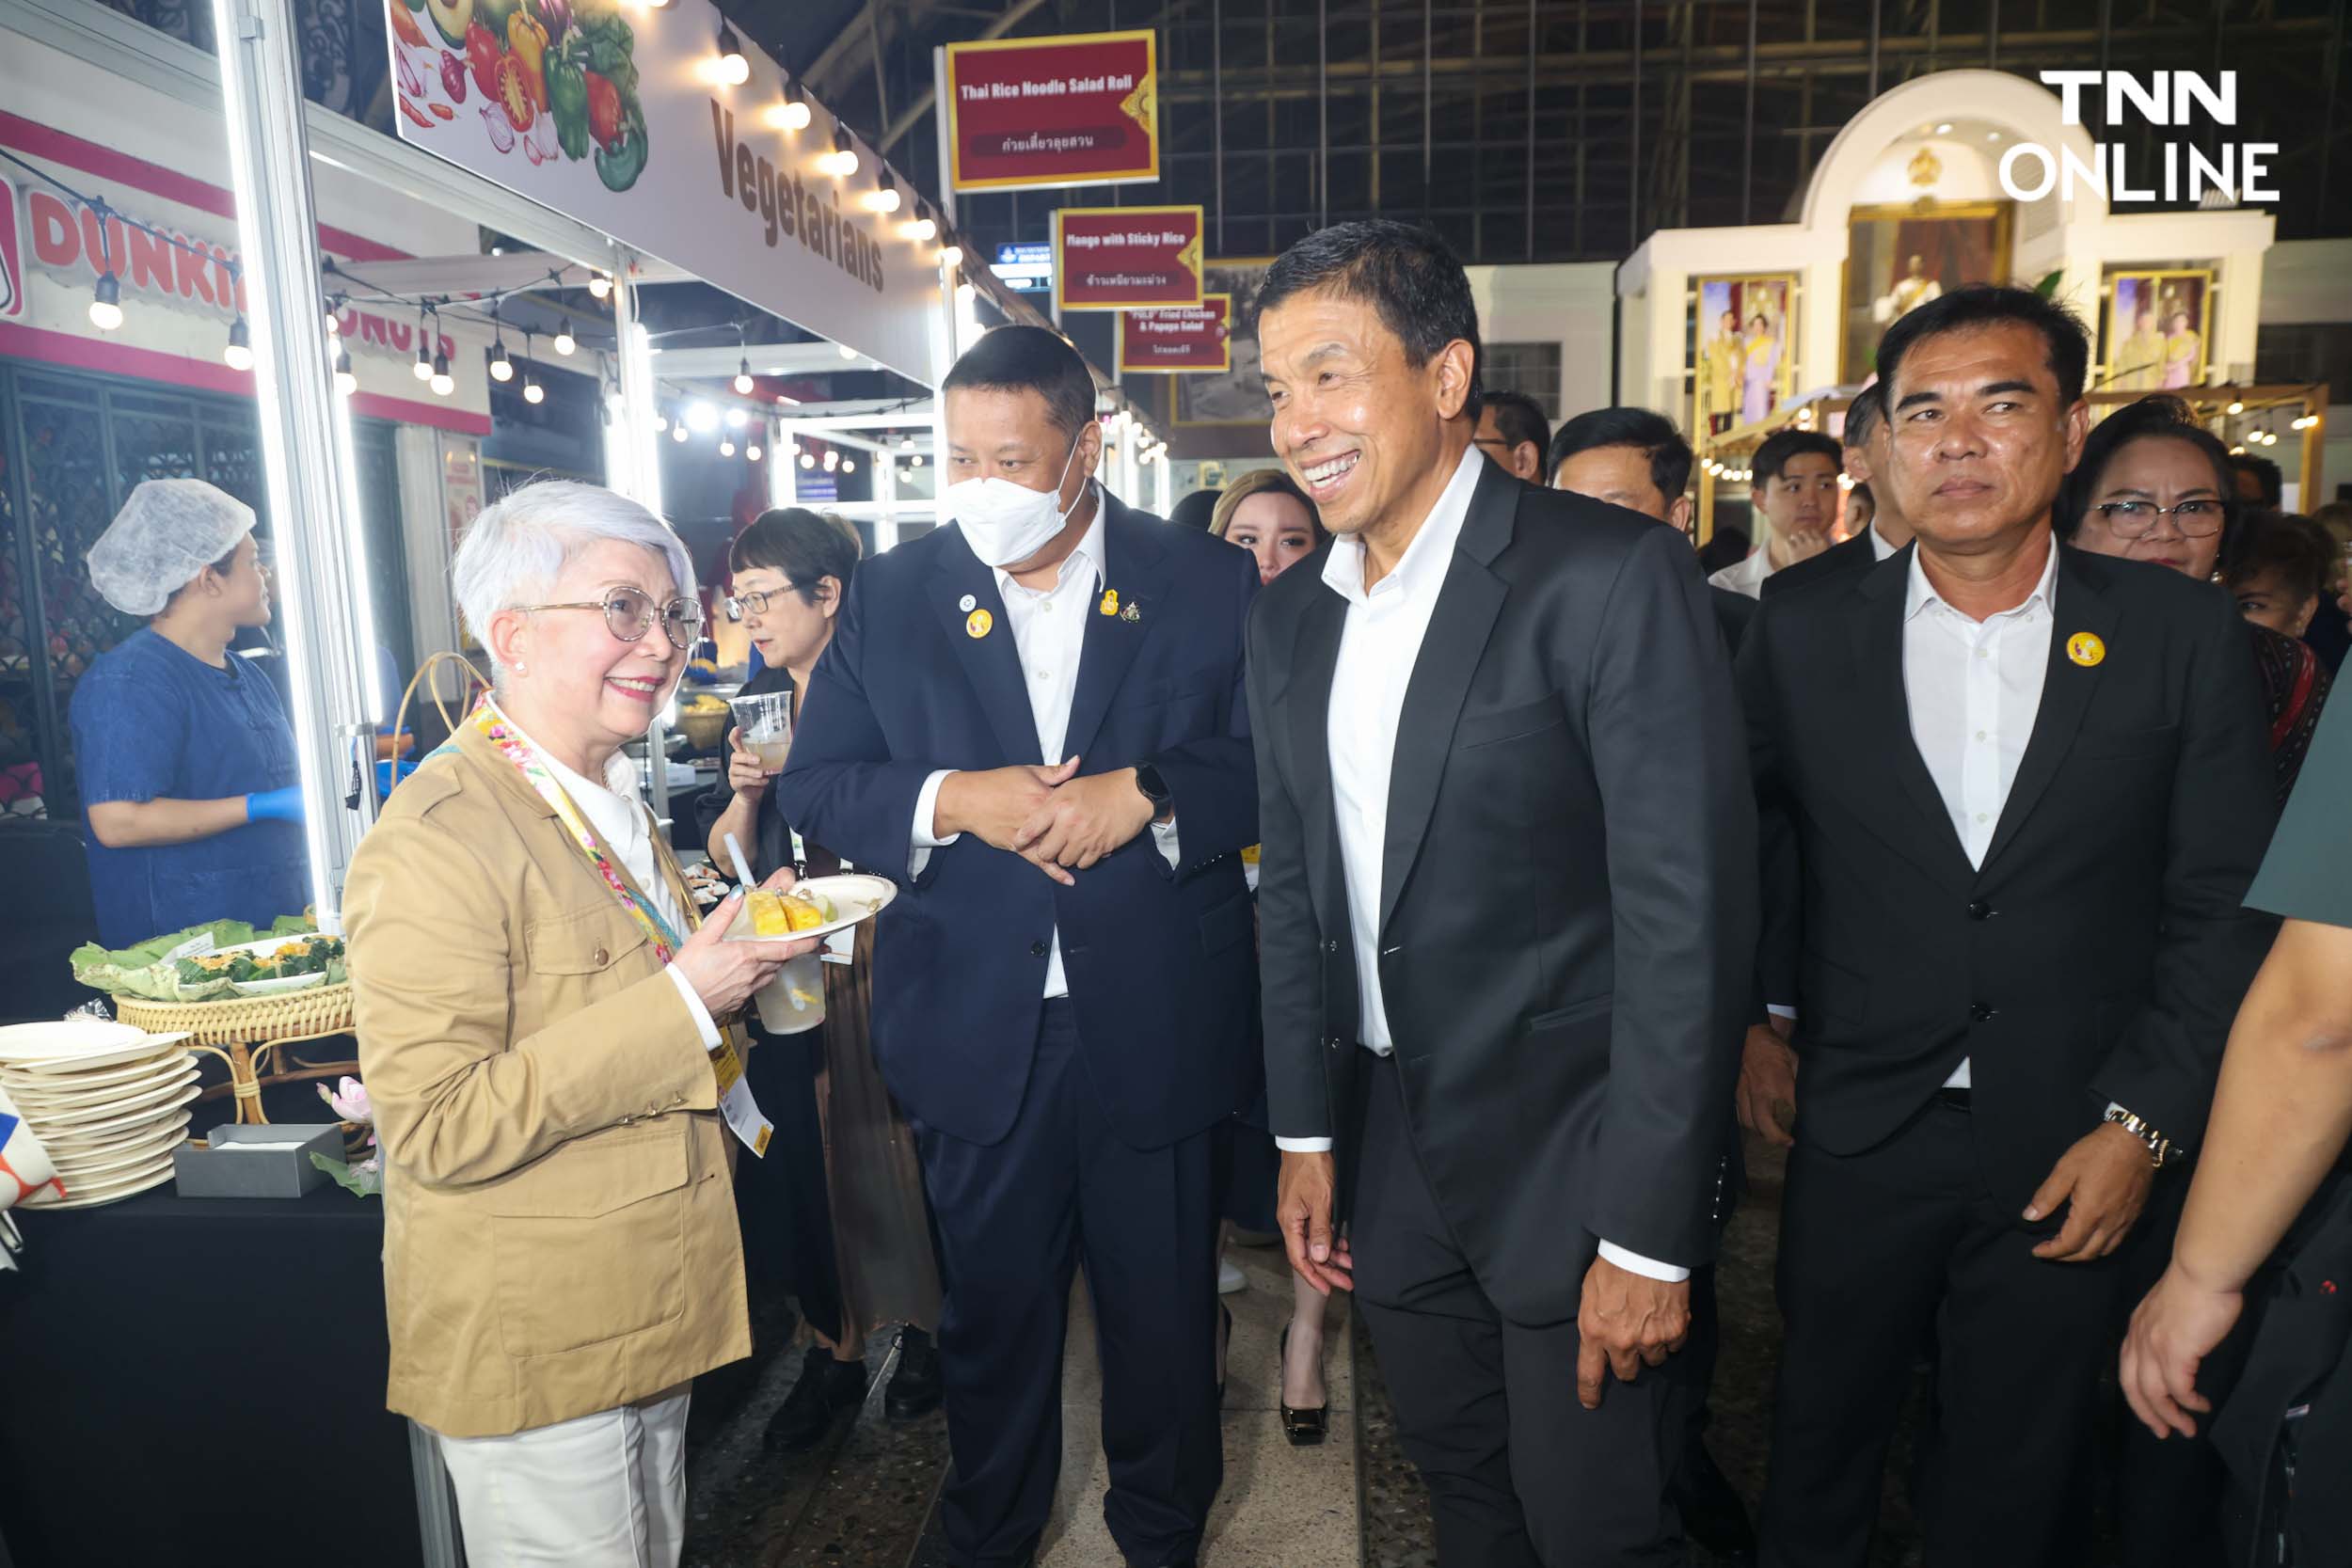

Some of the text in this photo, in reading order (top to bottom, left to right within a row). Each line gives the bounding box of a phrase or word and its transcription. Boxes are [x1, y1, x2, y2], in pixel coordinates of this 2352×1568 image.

[961, 74, 1133, 100] Thai Rice Noodle Salad Roll
[710, 97, 883, 293] Vegetarians
[29, 192, 248, 312] DUNKI
[1066, 230, 1186, 248] Mango with Sticky Rice
